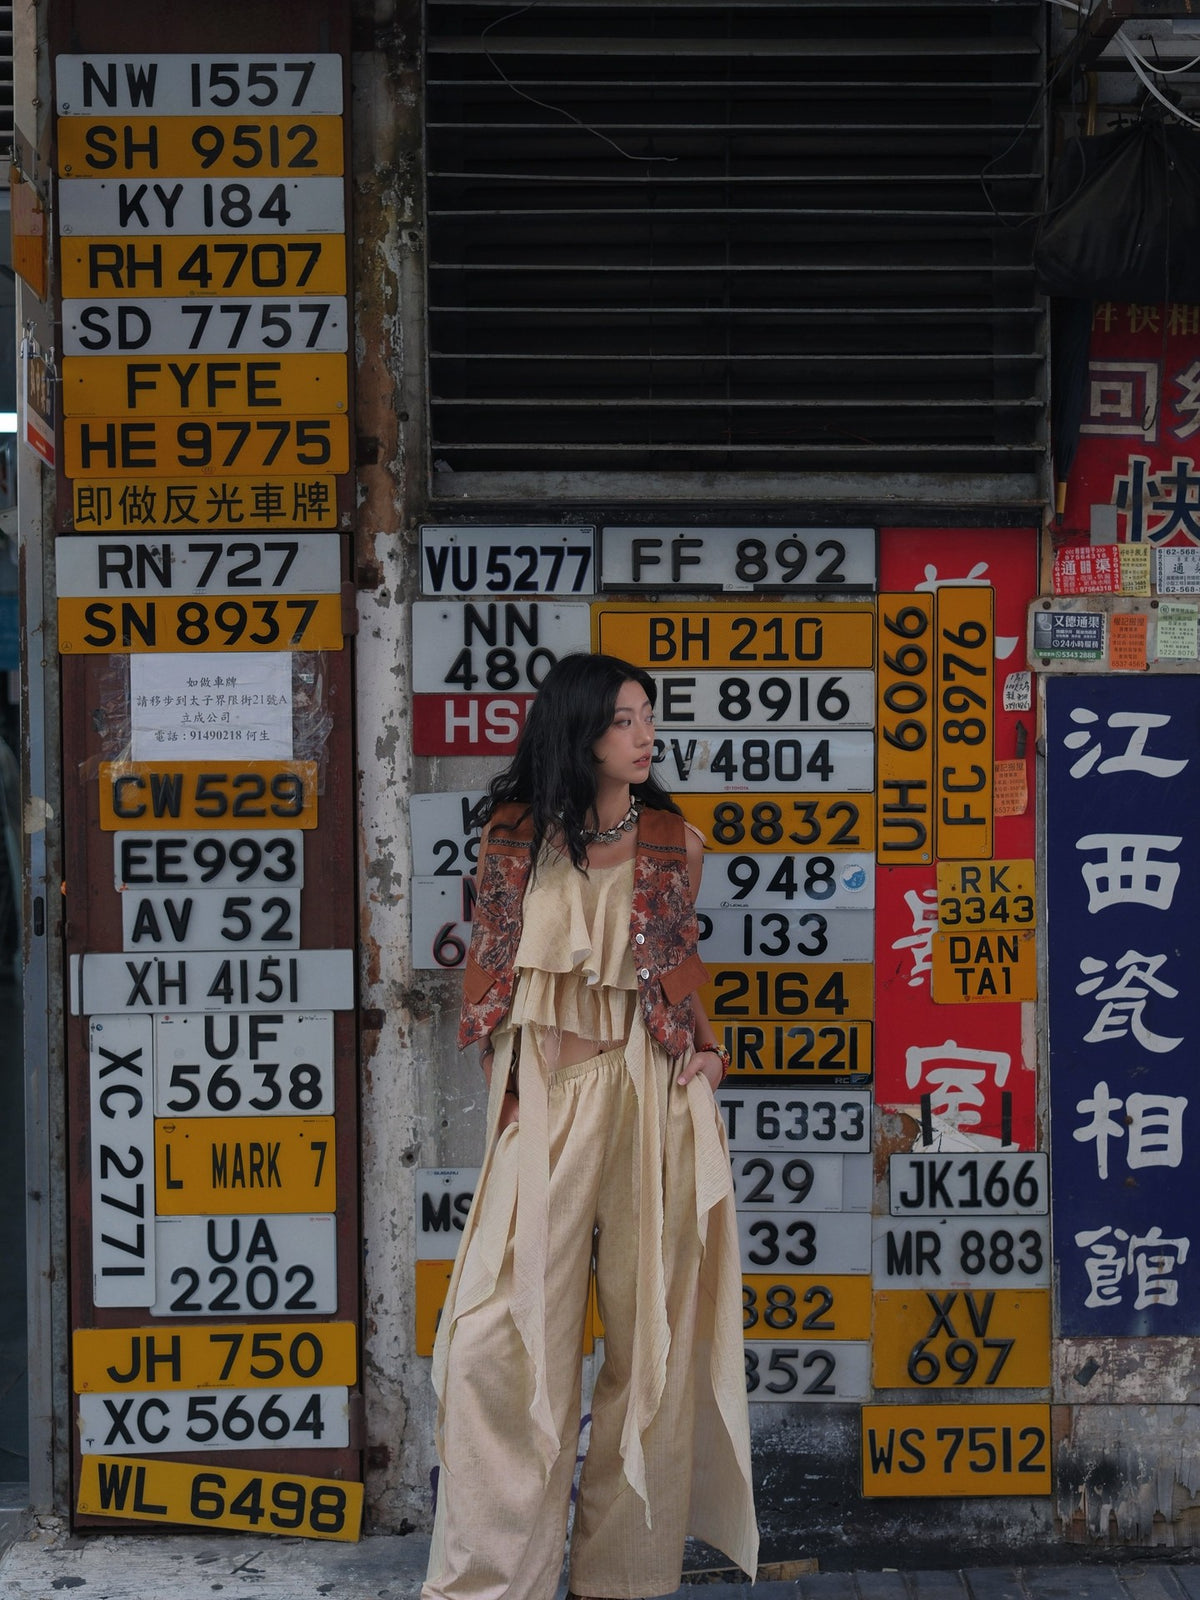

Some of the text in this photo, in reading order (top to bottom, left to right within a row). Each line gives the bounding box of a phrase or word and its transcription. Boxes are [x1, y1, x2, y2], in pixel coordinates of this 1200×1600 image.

[83, 62, 317, 108] NW 1557
[85, 124, 319, 170] SH 9512
[118, 183, 291, 228] KY 184
[88, 243, 322, 288] RH 4707
[78, 304, 331, 350] SD 7757
[126, 362, 282, 409] FYFE
[80, 423, 156, 468] HE
[176, 421, 331, 467] 9775
[75, 481, 330, 526] 即做反光車牌
[98, 542, 299, 589] RN 727
[425, 545, 592, 592] VU 5277
[632, 538, 846, 583] FF 892
[83, 600, 319, 647] SN 8937
[464, 603, 538, 646] NN
[649, 617, 823, 661] BH 210
[186, 676, 237, 689] 如做車牌
[444, 647, 557, 691] 480
[883, 606, 927, 752] 6066
[180, 712, 232, 724] 立成公司
[445, 699, 535, 744] HS
[655, 677, 850, 721] E 8916
[242, 729, 271, 742] 何生
[943, 620, 986, 825] FC 8976
[710, 739, 835, 782] 4804
[112, 773, 305, 818] CW 529
[882, 780, 927, 851] UH
[712, 801, 860, 845] 8832
[121, 838, 296, 883] EE993
[727, 856, 837, 900] 948
[961, 866, 1011, 894] RK
[131, 897, 293, 943] AV 52
[940, 896, 1034, 925] 3343
[744, 913, 828, 957] 133
[949, 935, 1019, 963] DAN
[125, 958, 298, 1006] XH 4151
[714, 971, 849, 1015] 2164
[954, 967, 1012, 995] TA1
[204, 1014, 284, 1060] UF
[775, 1026, 858, 1070] 1221
[166, 1063, 323, 1112] 5638
[720, 1100, 865, 1141] T 6333
[98, 1047, 145, 1276] XC 2771
[166, 1141, 328, 1189] L MARK 7
[730, 1158, 815, 1204] 29
[899, 1159, 1040, 1209] JK166
[206, 1218, 278, 1264] UA
[748, 1220, 817, 1266] 33
[886, 1229, 1044, 1276] MR 883
[169, 1264, 317, 1312] 2202
[926, 1291, 996, 1338] XV
[106, 1332, 324, 1384] JH 750
[906, 1338, 1016, 1385] 697
[102, 1394, 325, 1446] XC 5664
[868, 1426, 1046, 1475] WS 7512
[97, 1462, 347, 1533] WL 6498
